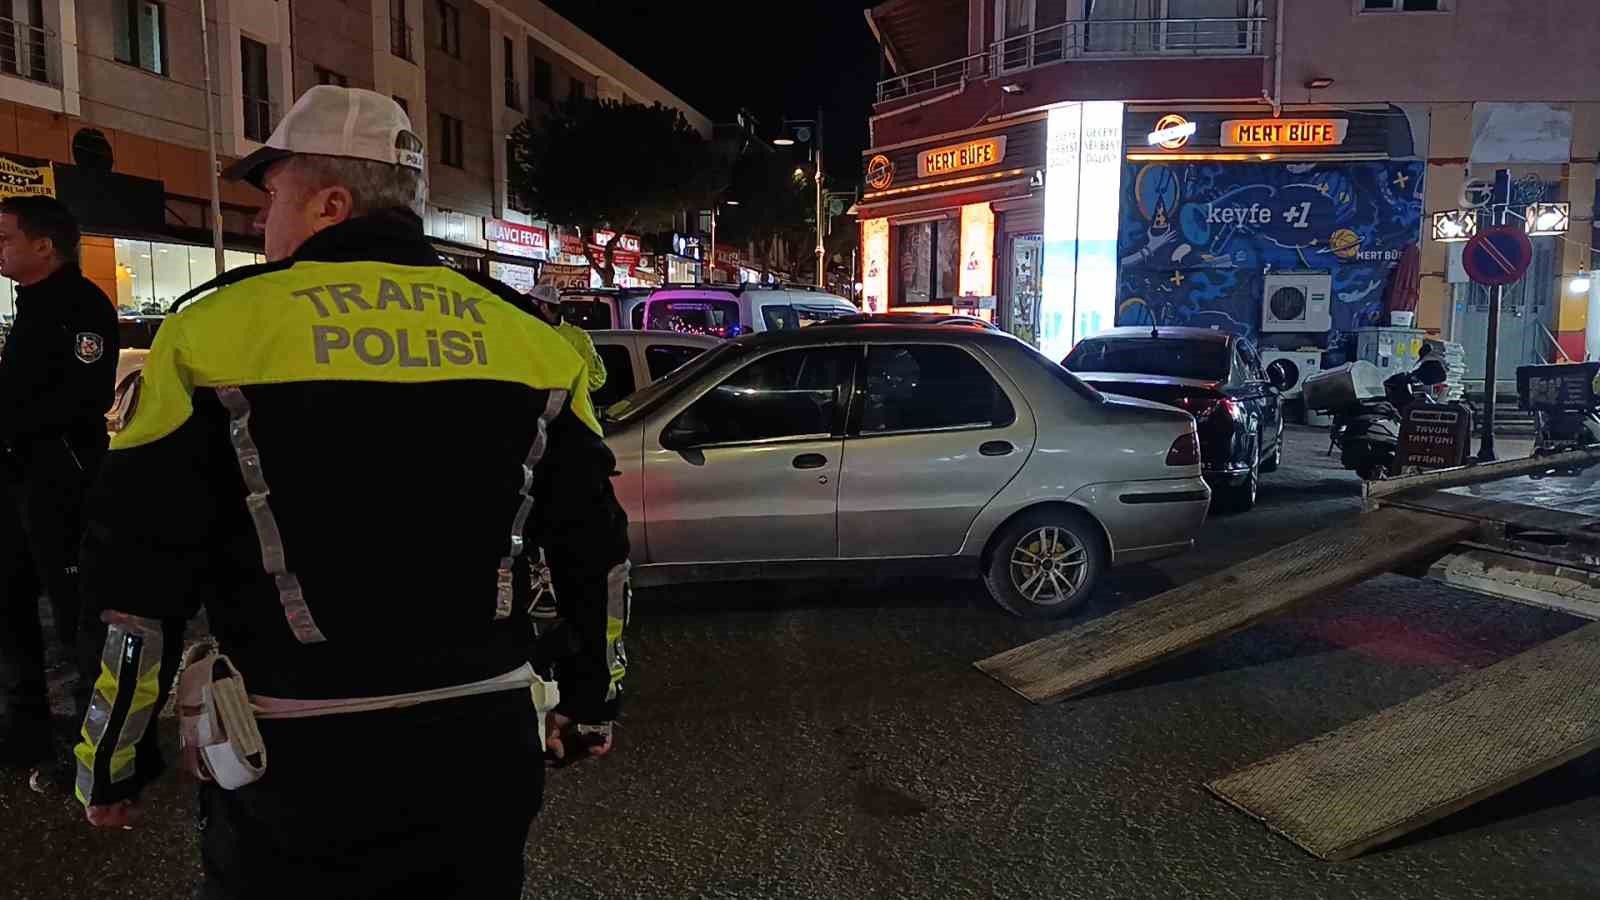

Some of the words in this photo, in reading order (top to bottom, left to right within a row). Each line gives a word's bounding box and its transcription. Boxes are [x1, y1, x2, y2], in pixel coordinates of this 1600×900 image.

[1239, 124, 1283, 141] MERT
[1289, 120, 1333, 141] BÜFE
[926, 151, 956, 173] MERT
[960, 143, 992, 166] BÜFE
[1206, 202, 1272, 228] keyfe
[1282, 201, 1312, 228] +1
[1356, 250, 1383, 261] MERT
